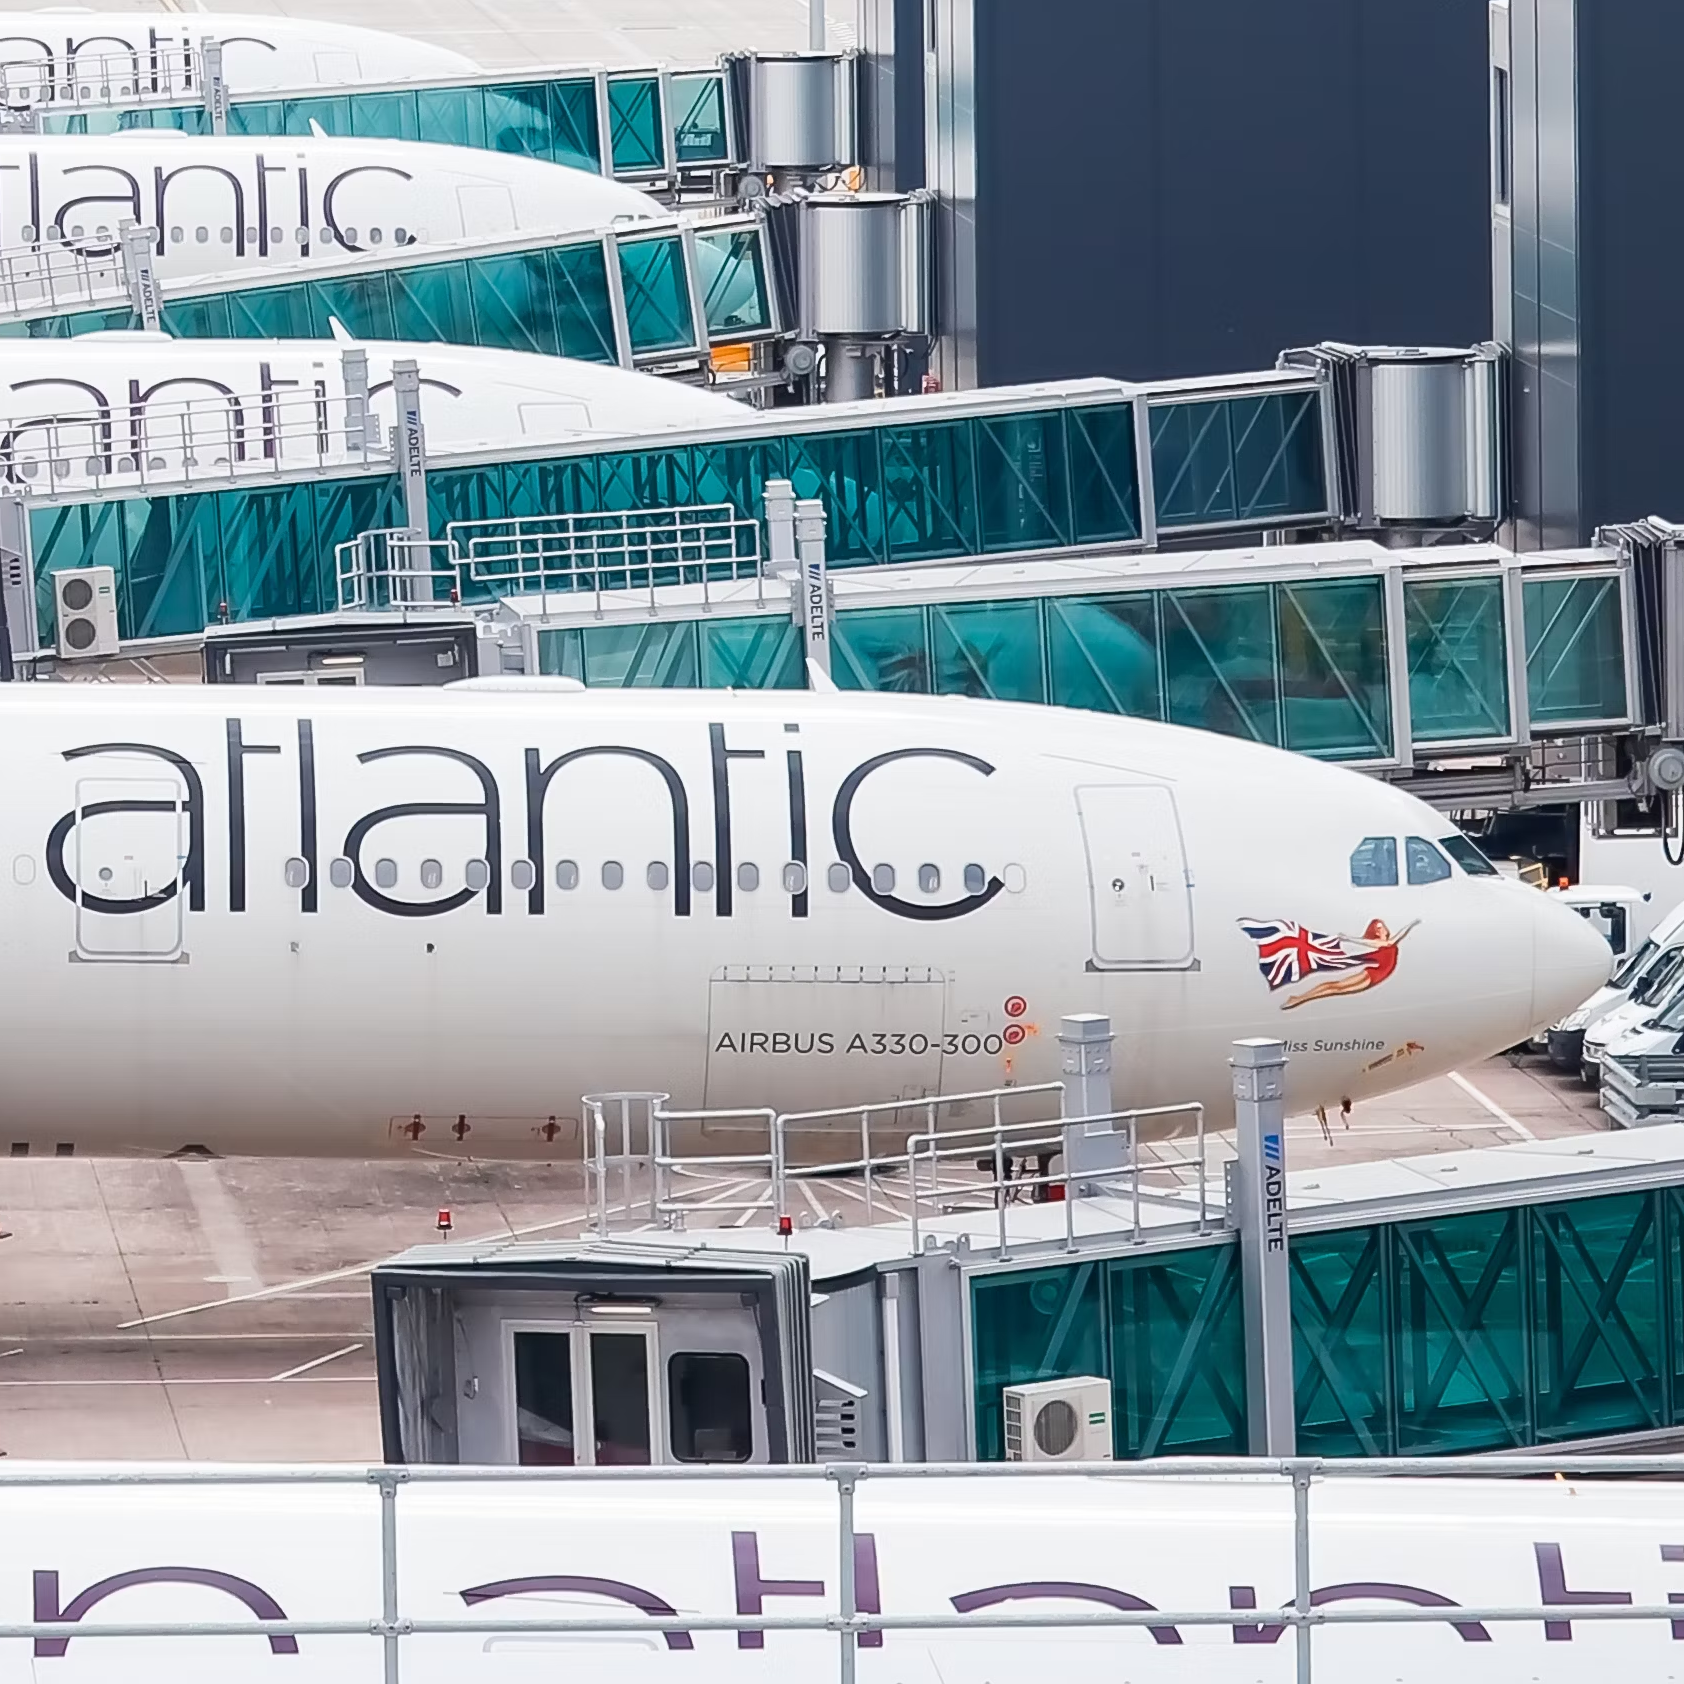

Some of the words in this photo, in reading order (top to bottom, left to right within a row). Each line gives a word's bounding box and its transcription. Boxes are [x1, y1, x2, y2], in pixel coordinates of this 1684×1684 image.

[142, 283, 156, 323] ADELTE
[408, 428, 422, 477] ADELTE
[809, 583, 825, 641] ADELTE
[45, 718, 1006, 922] atlantic
[715, 1032, 835, 1054] AIRBUS
[845, 1033, 1003, 1055] A330-300
[1313, 1038, 1385, 1052] Sunshine
[1265, 1165, 1283, 1252] ADELTE
